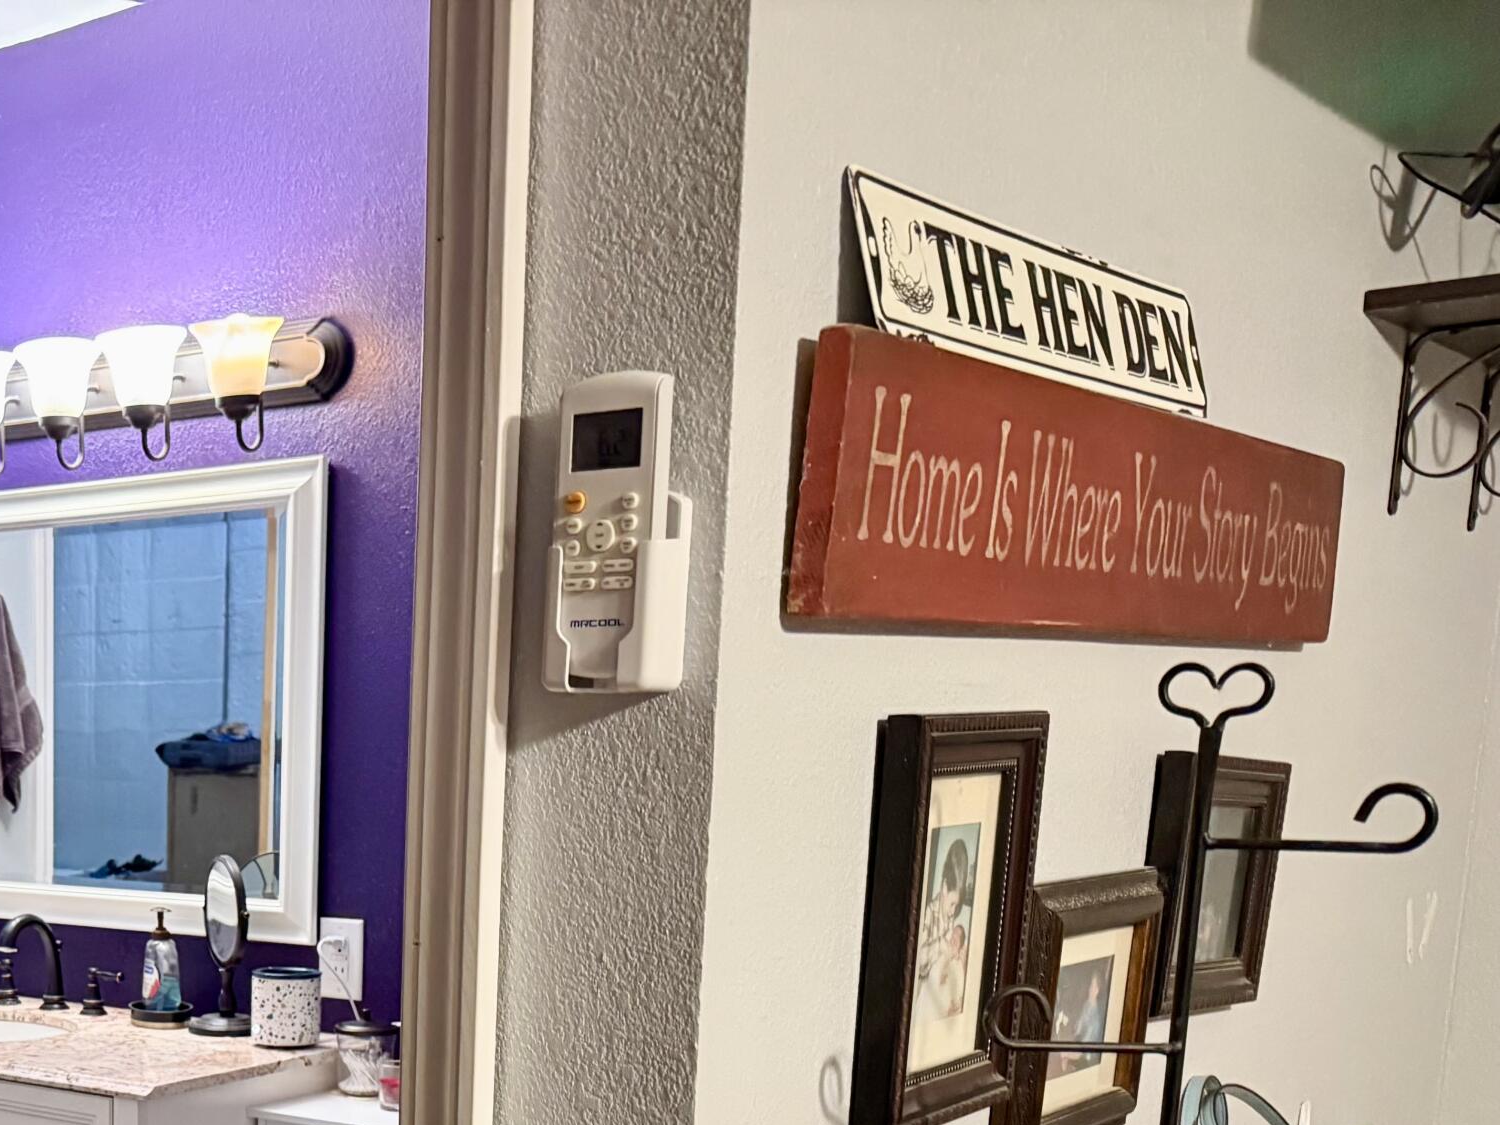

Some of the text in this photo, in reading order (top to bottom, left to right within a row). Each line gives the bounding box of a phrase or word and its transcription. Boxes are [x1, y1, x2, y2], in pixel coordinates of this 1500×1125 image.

[924, 221, 1193, 391] THE HEN DEN
[857, 386, 1330, 614] Home Is Where Your Story Begins
[570, 618, 625, 628] MRCOOL
